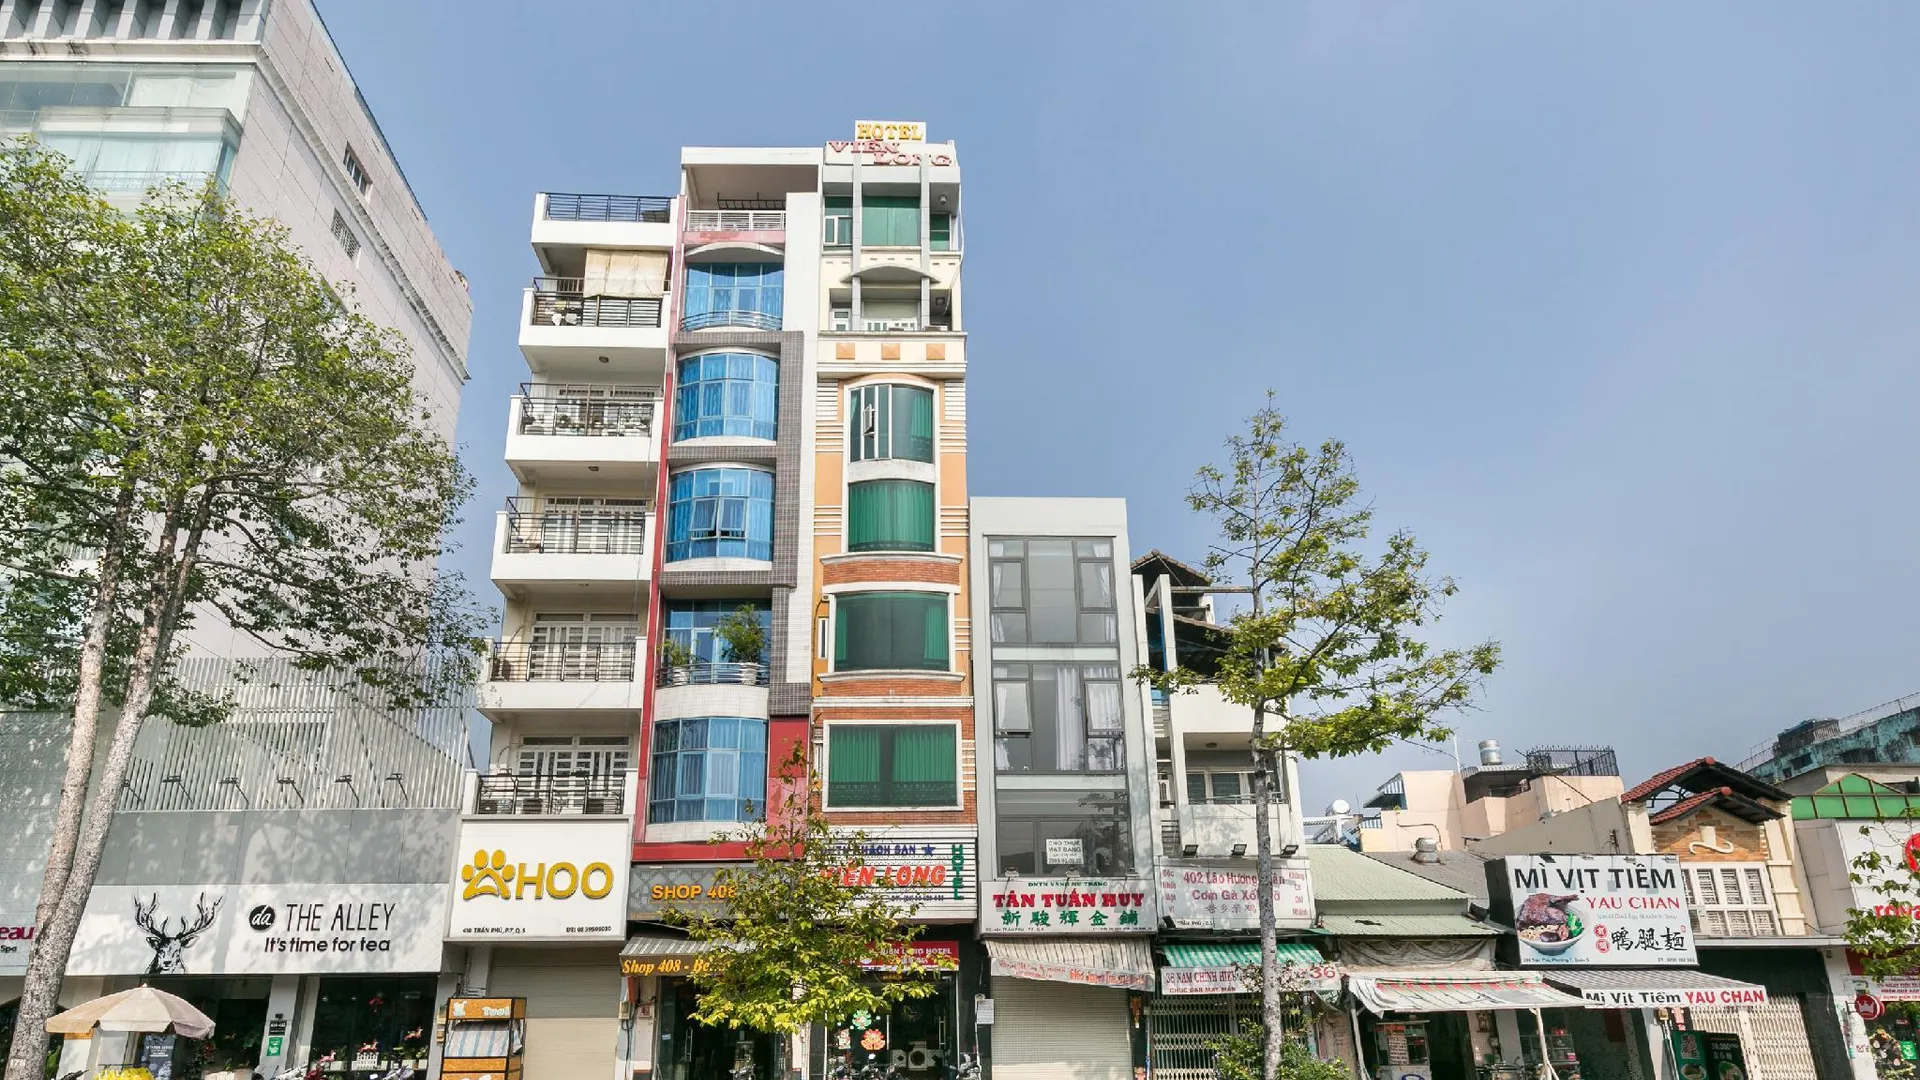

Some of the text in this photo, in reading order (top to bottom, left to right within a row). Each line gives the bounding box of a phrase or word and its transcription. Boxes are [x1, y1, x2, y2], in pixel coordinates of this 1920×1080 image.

[857, 124, 923, 141] HOTEL
[874, 153, 952, 167] LONG
[515, 862, 614, 899] HOO
[884, 865, 947, 887] LONG
[951, 844, 965, 901] HOTEL
[1183, 871, 1204, 885] 402
[1206, 871, 1225, 885] Lão
[1227, 871, 1258, 888] Hương
[1515, 862, 1549, 889] MÌ
[1556, 868, 1600, 893] VỊT
[651, 884, 738, 900] SHOP 408
[993, 888, 1145, 908] TÂN TUẤN HUY
[1191, 889, 1218, 901] Cơm
[1221, 889, 1238, 901] Gà
[1585, 896, 1680, 909] YAU CHAN
[286, 903, 396, 931] THE ALLEY
[1, 944, 17, 954] Spa
[264, 937, 391, 952] It's time for tea
[925, 947, 952, 955] HOTEL
[622, 959, 655, 977] Shop
[657, 959, 681, 973] 408
[1311, 965, 1336, 979] 36
[1165, 972, 1176, 984] 36
[1610, 992, 1635, 1006] Vịt
[1684, 991, 1716, 1004] YAU
[1720, 990, 1765, 1004] CHAN
